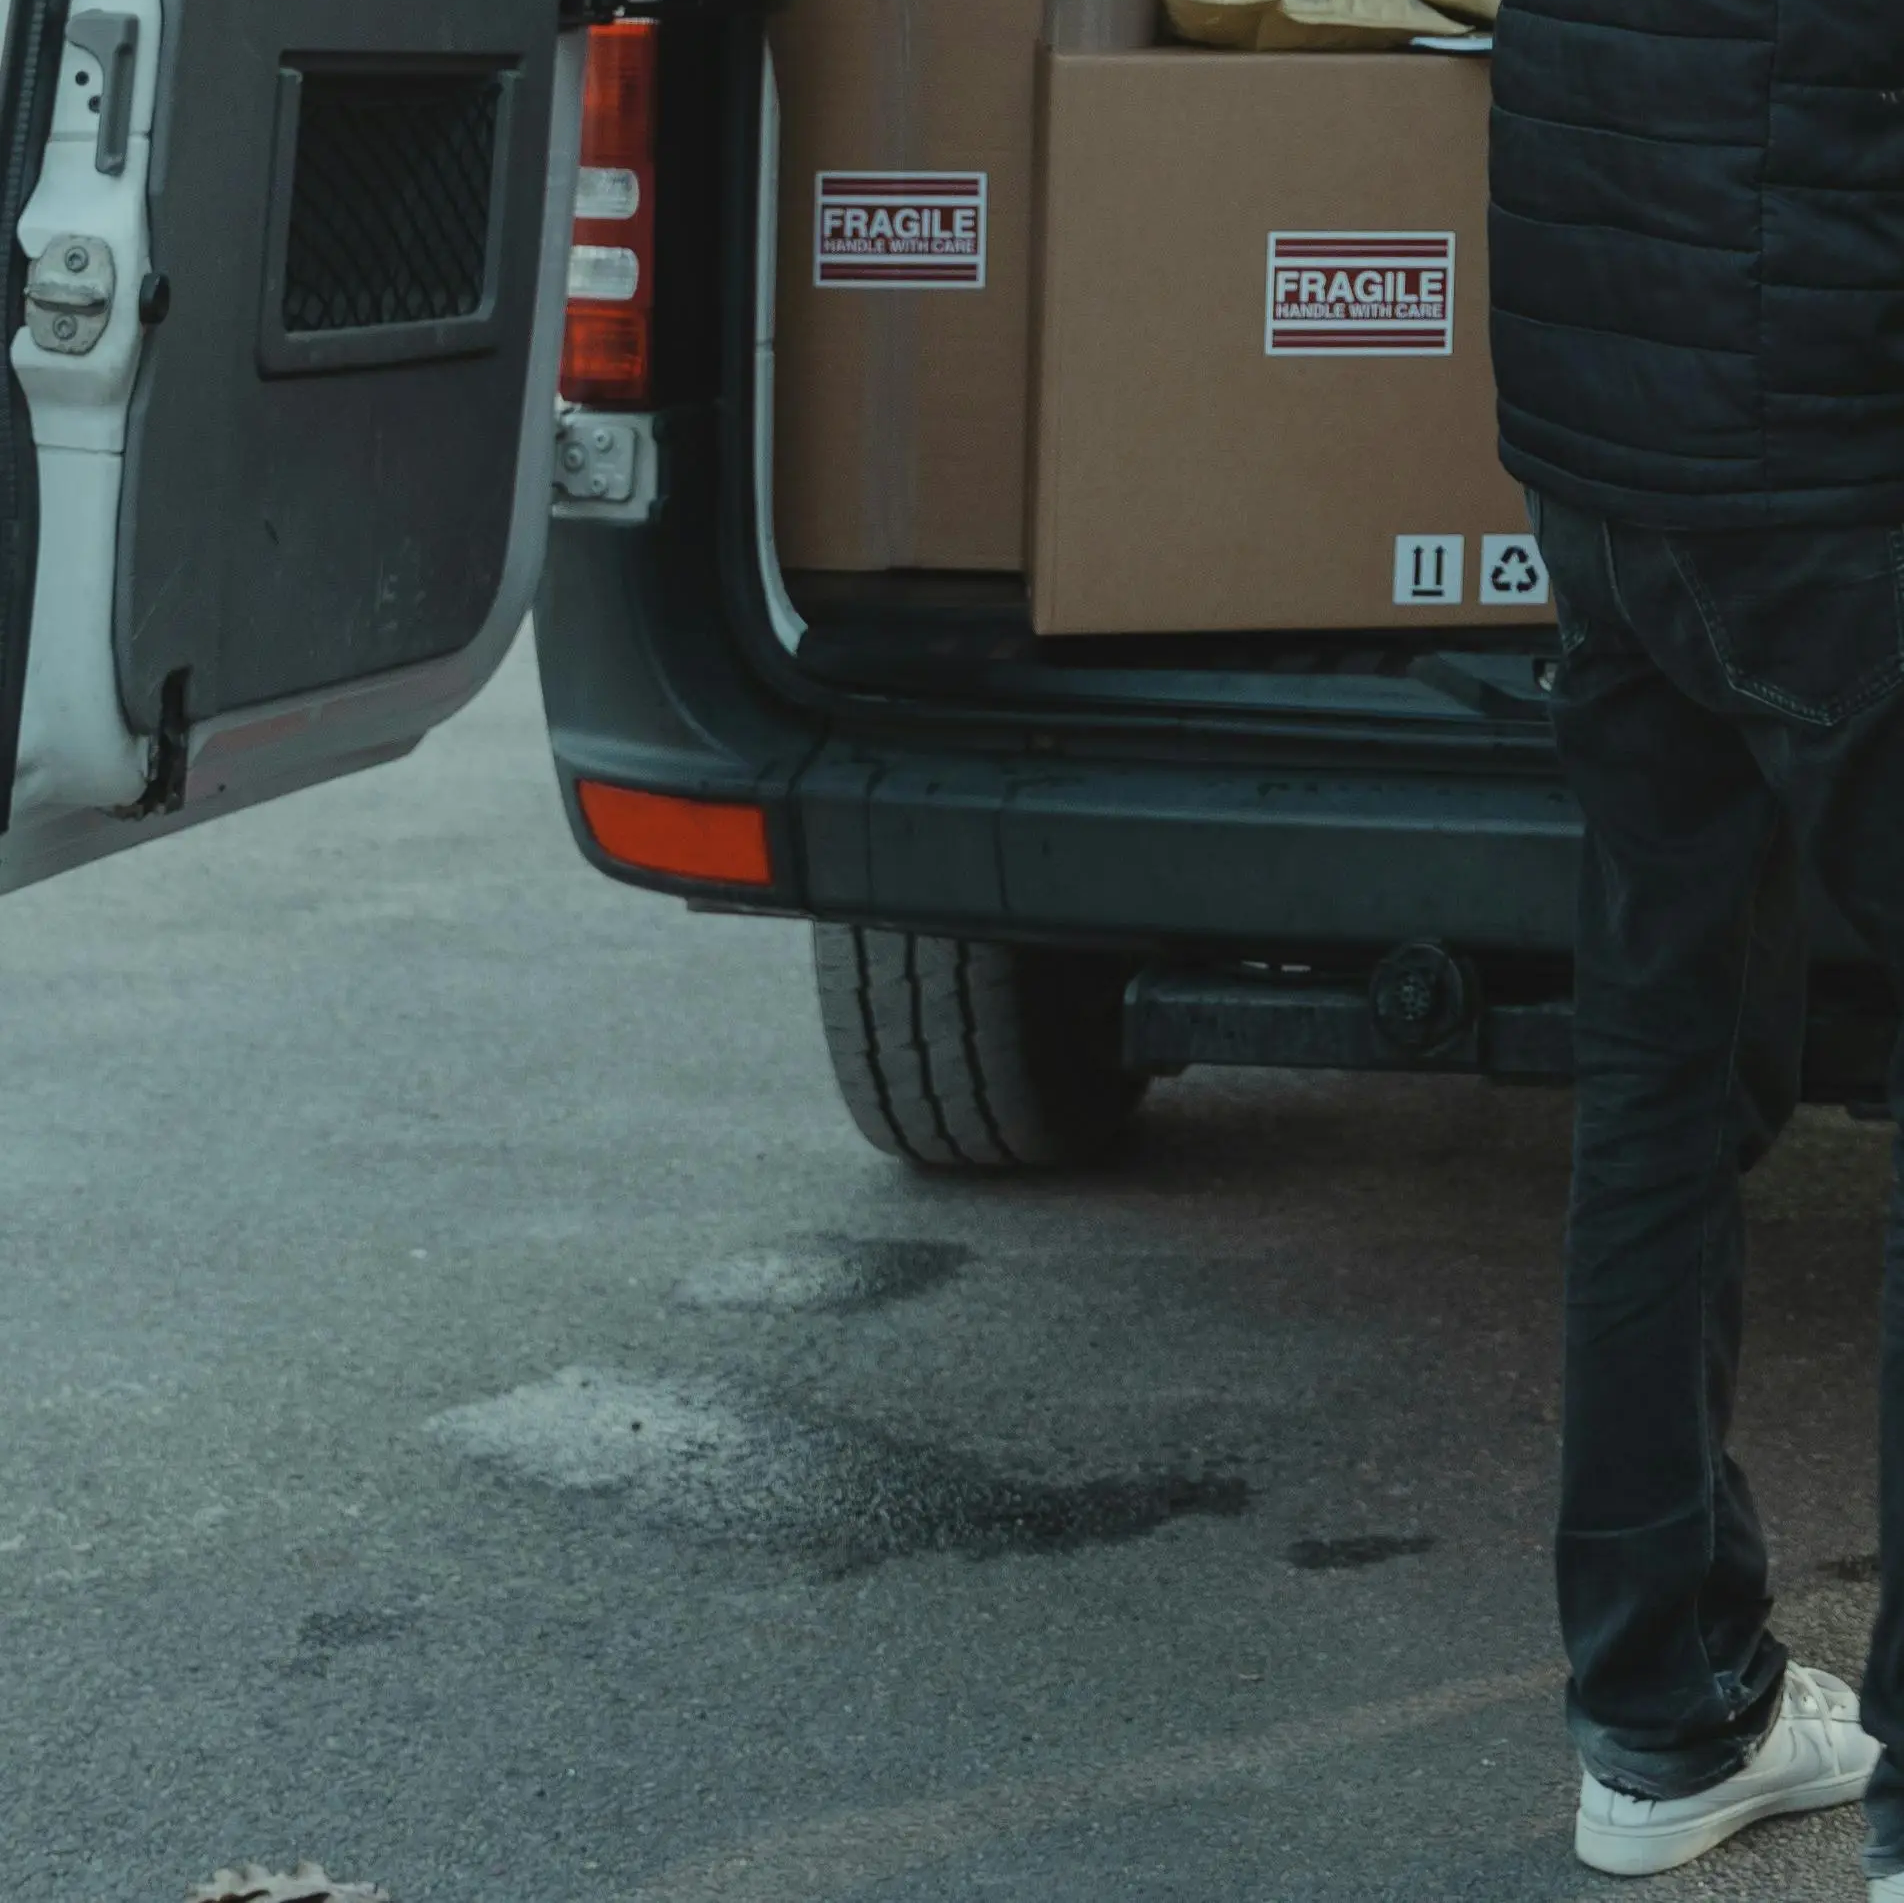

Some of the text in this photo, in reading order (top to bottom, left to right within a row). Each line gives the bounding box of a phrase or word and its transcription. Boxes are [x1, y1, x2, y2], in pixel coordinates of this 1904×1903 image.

[823, 208, 976, 238] FRAGILE
[824, 238, 976, 253] HANDLE WITH CARE
[1275, 270, 1444, 303] FRAGILE
[1275, 303, 1443, 318] HANDLE WITH CARE
